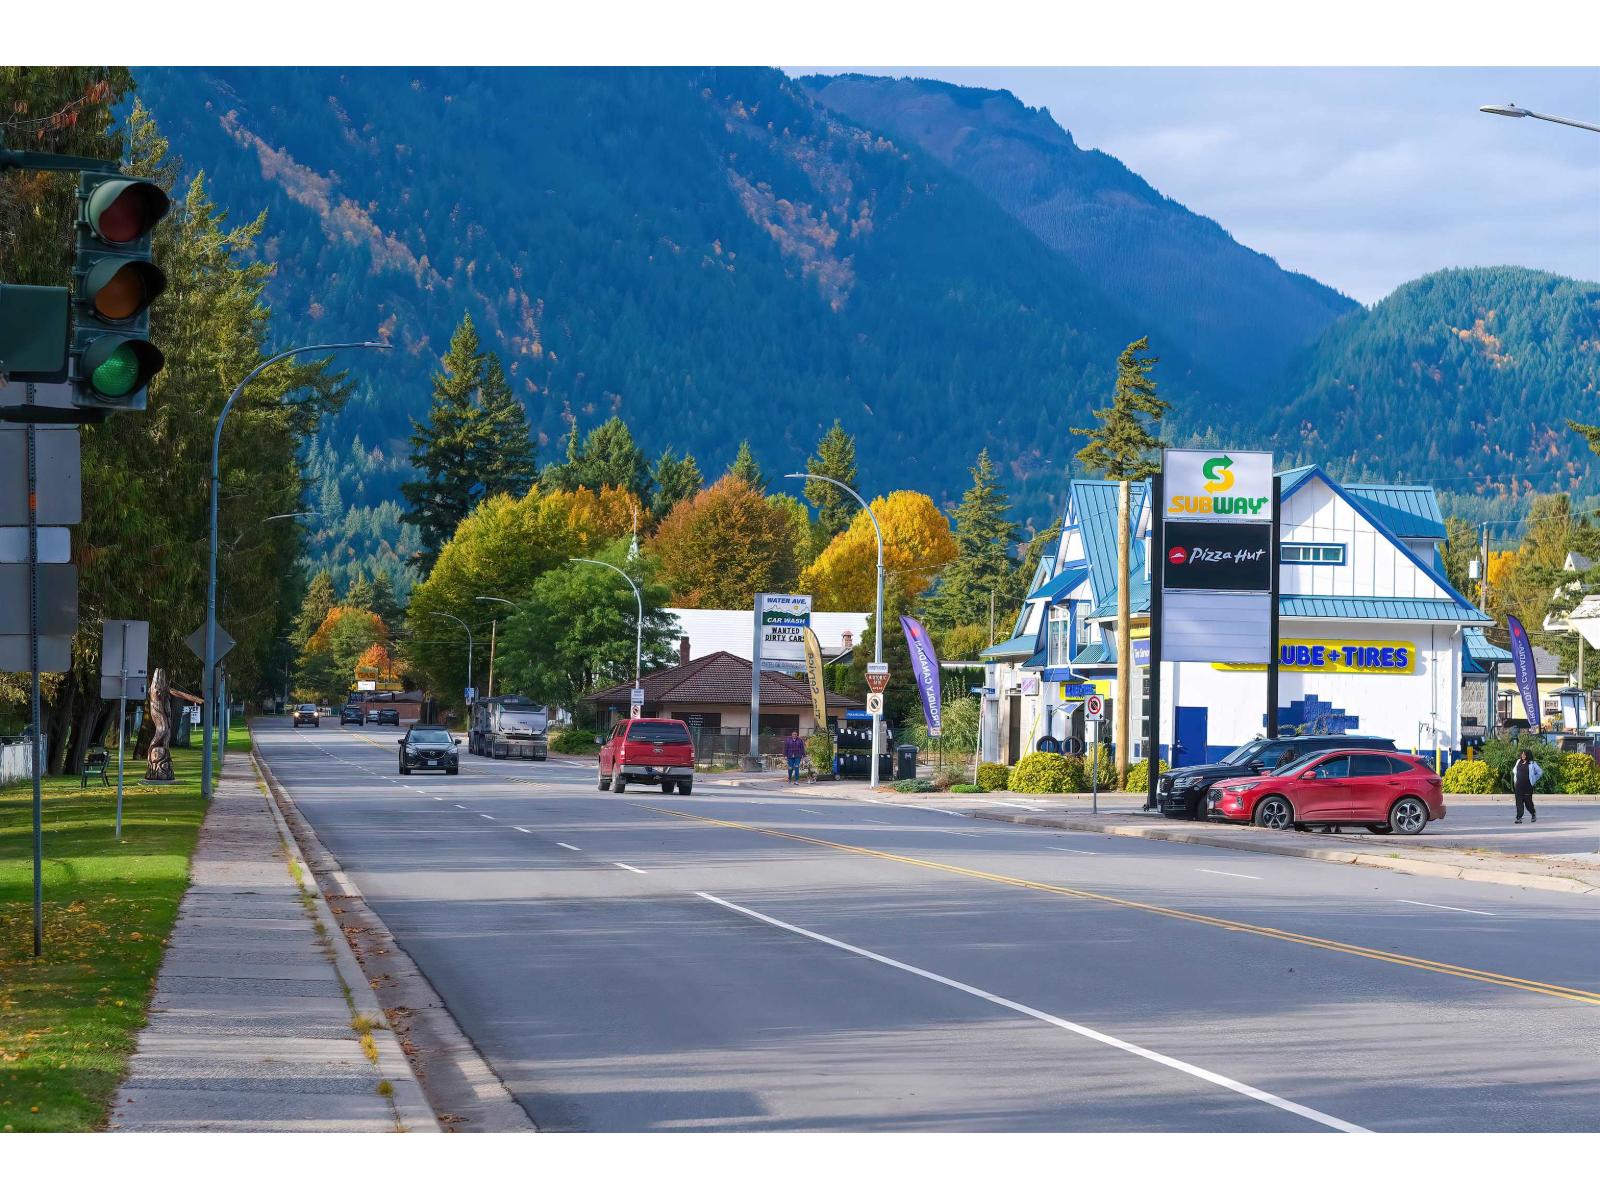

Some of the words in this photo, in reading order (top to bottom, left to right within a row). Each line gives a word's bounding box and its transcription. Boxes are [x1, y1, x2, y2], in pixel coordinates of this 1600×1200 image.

[1167, 495, 1270, 515] SUBWAY
[1189, 547, 1232, 565] Pizza
[1234, 548, 1266, 564] Hut
[765, 634, 786, 642] DIRTY
[1278, 645, 1325, 666] UBE
[1342, 646, 1408, 668] TIRES
